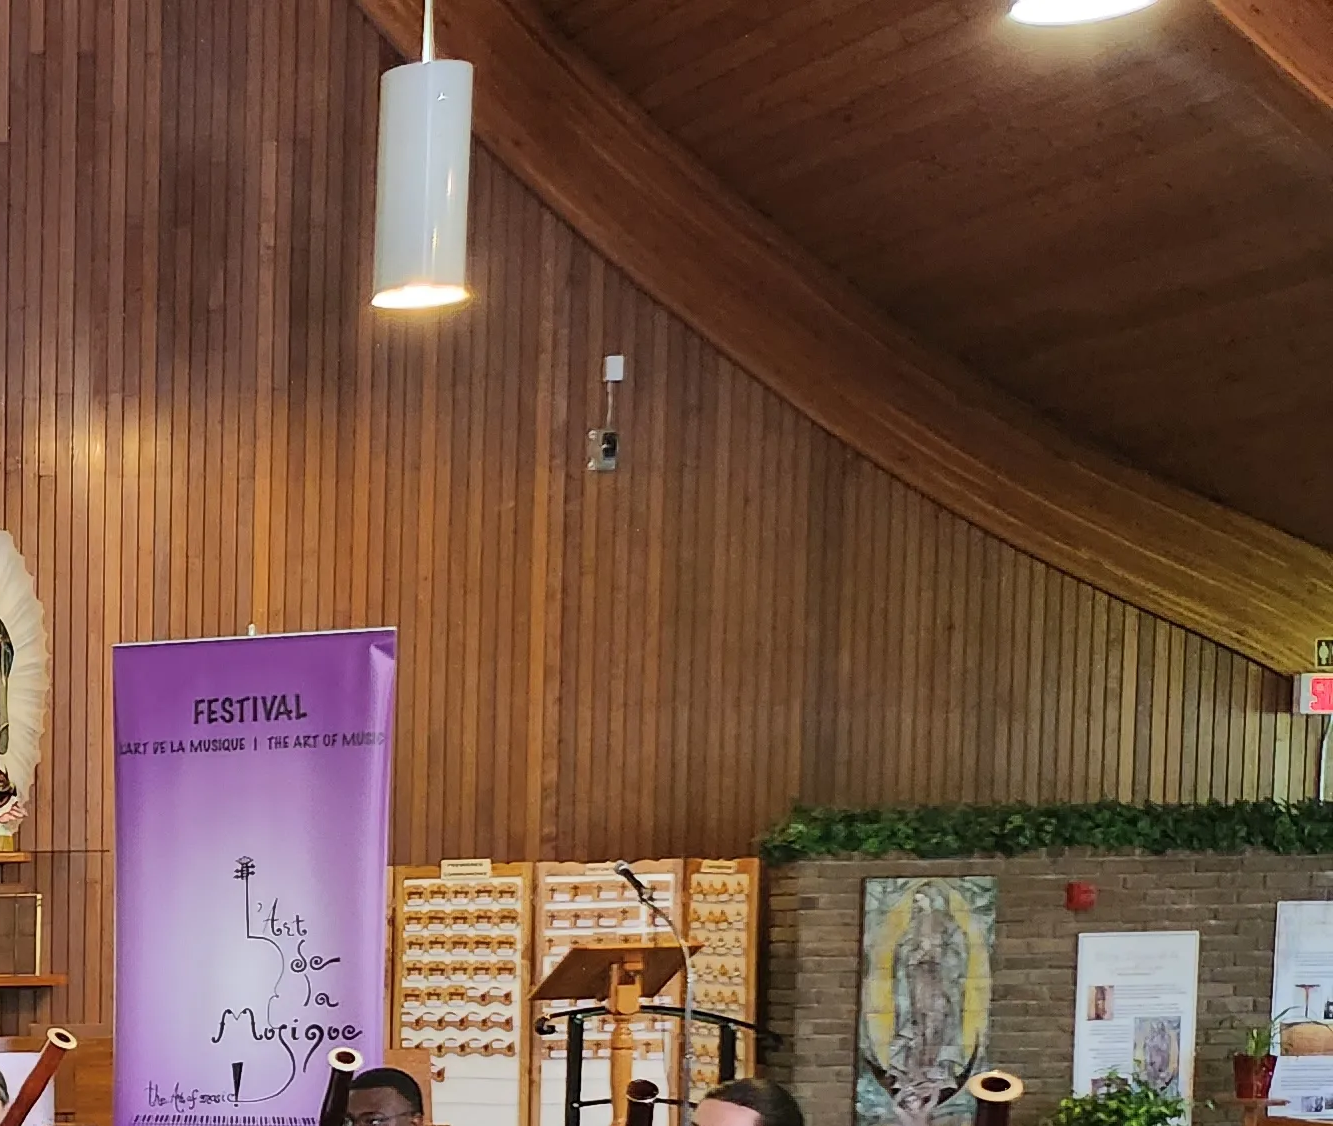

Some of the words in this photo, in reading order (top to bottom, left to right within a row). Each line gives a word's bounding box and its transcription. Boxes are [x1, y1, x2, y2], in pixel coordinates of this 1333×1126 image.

[193, 693, 307, 725] FESTIVAL
[170, 740, 185, 753] LA
[189, 737, 245, 752] MUSIQUE
[267, 735, 289, 750] THE
[293, 734, 319, 749] ART
[322, 733, 338, 747] OF
